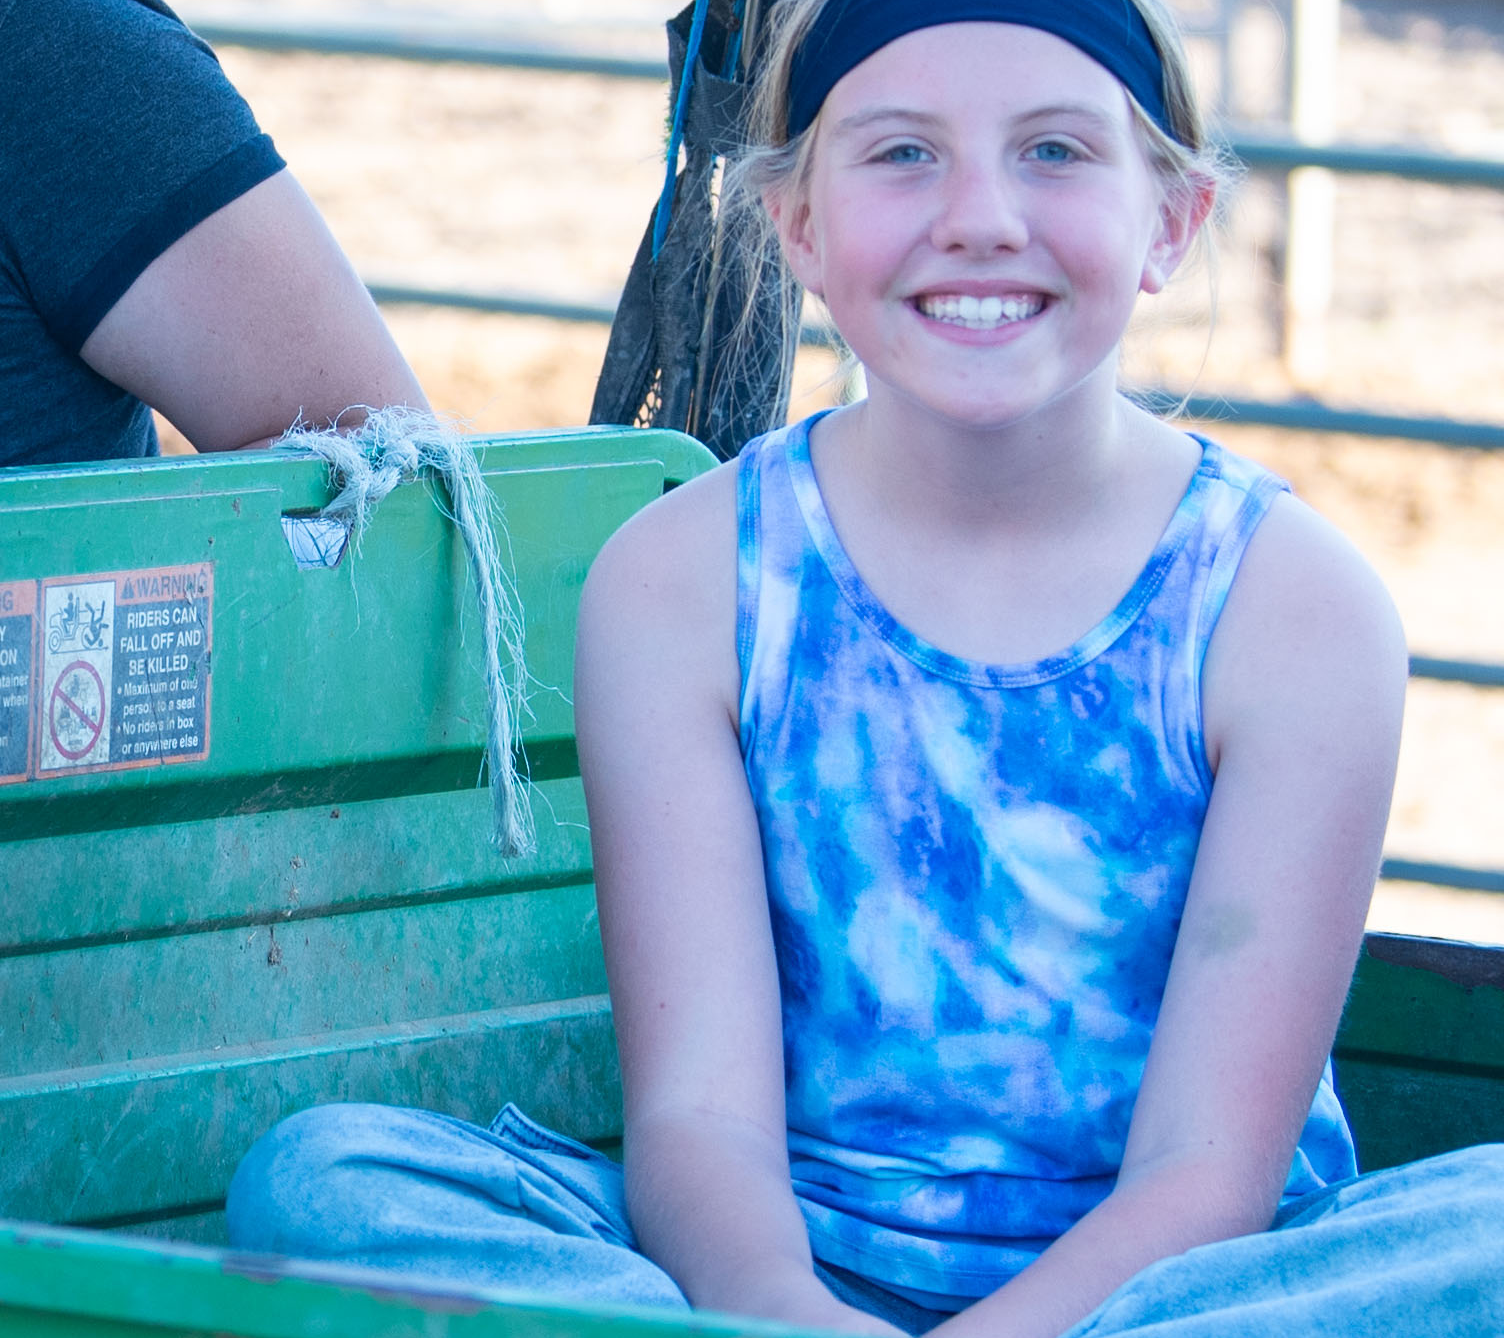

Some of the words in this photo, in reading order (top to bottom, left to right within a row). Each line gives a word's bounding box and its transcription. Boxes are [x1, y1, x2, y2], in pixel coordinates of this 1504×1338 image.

[136, 568, 208, 598] WARNING
[127, 609, 170, 629] RIDERS
[172, 606, 197, 624] CAN
[120, 635, 148, 653] FALL
[151, 632, 175, 650] OFF
[176, 629, 201, 647] AND
[128, 658, 145, 676] BE
[147, 654, 189, 674] KILLED
[123, 682, 167, 697] Maximum
[169, 677, 179, 691] of
[2, 693, 29, 707] when
[157, 701, 167, 712] to
[168, 700, 175, 710] a
[176, 696, 196, 710] seat
[122, 721, 136, 735] No
[137, 720, 164, 734] riders
[177, 716, 194, 729] box
[121, 743, 132, 755] or
[133, 738, 178, 756] anywhere
[179, 734, 199, 748] else
